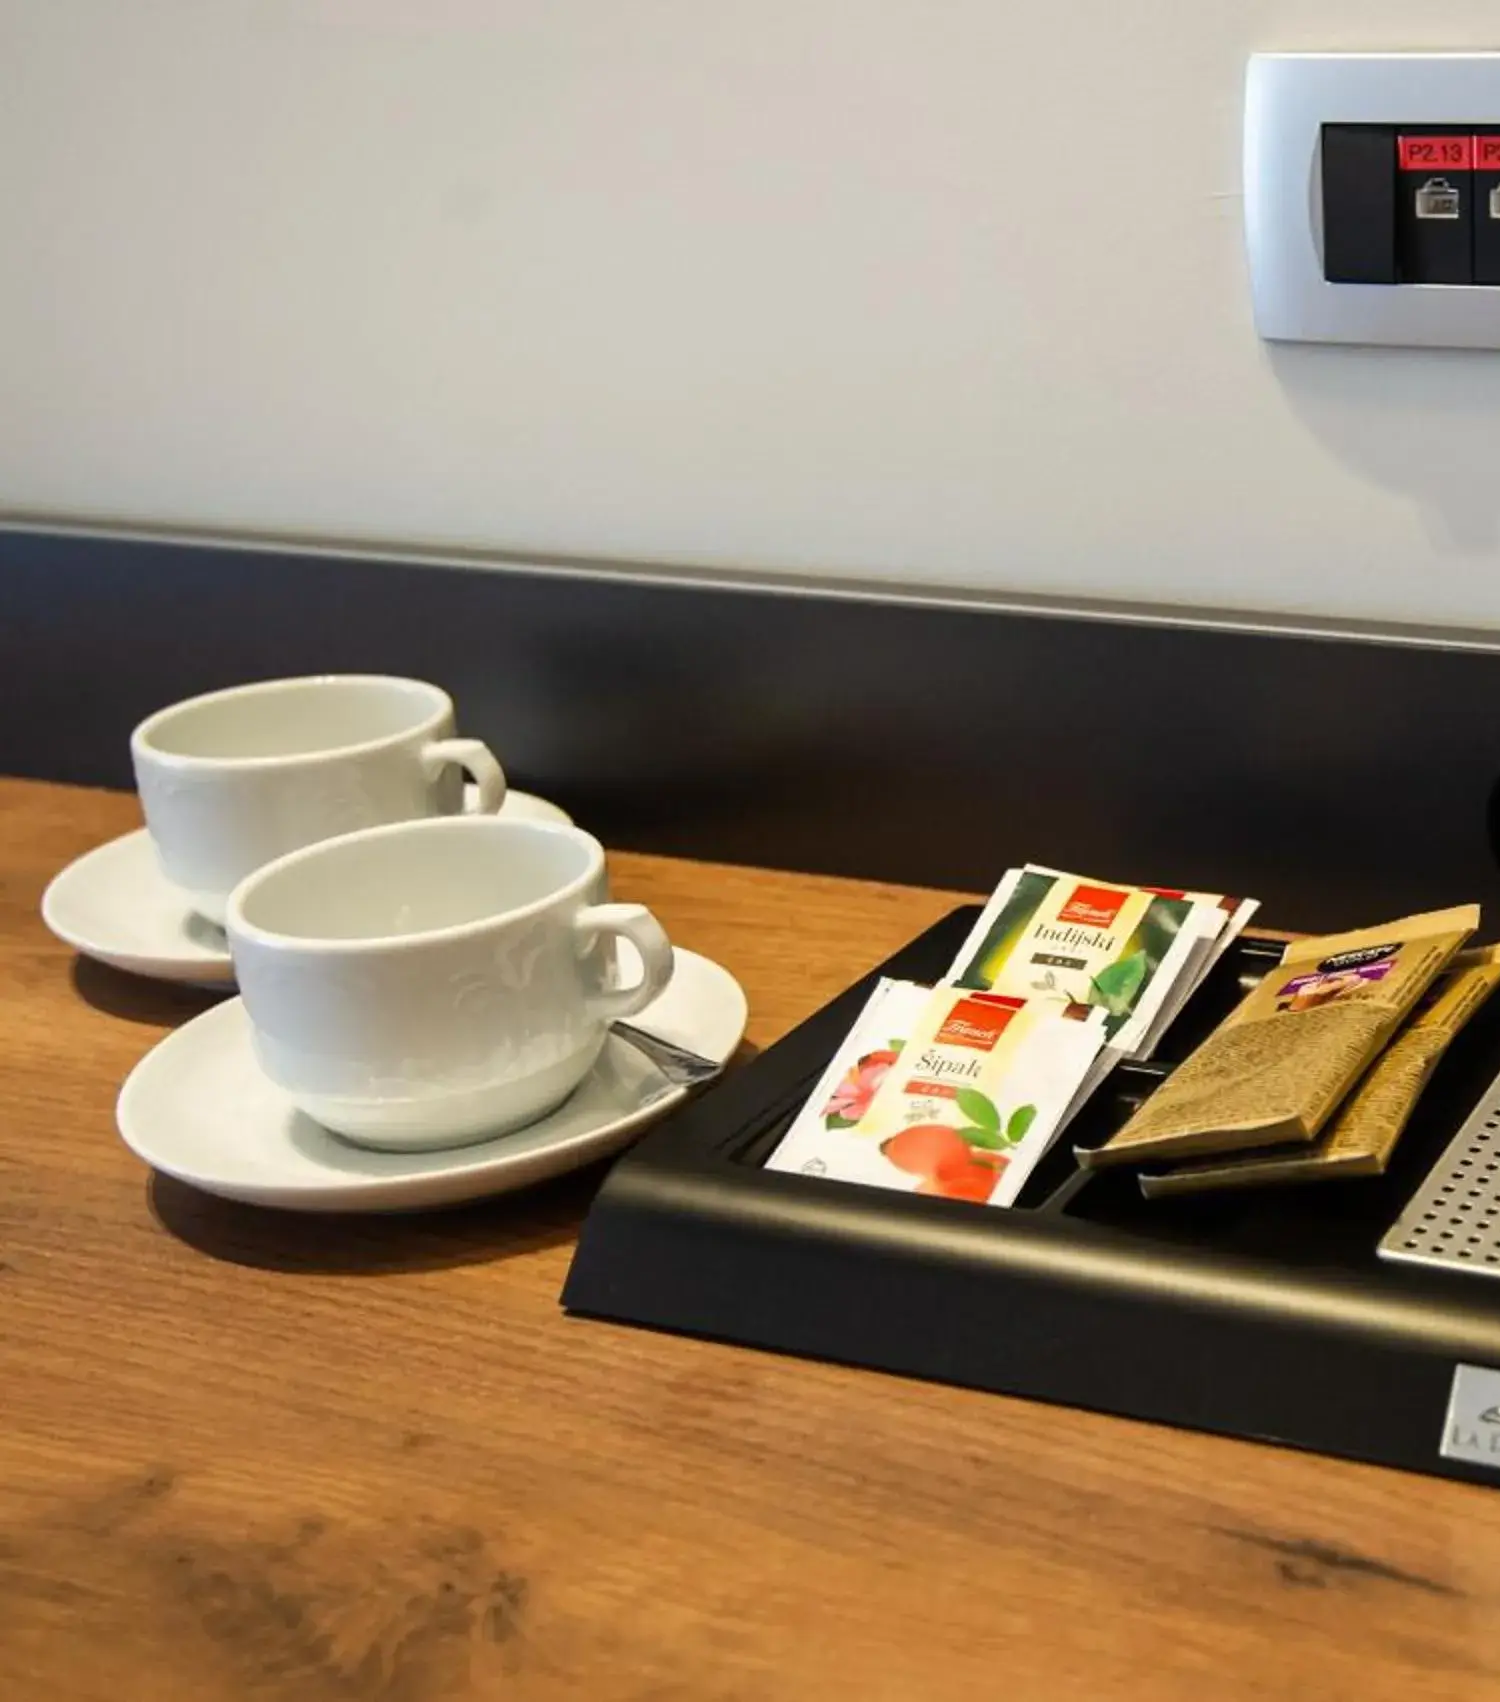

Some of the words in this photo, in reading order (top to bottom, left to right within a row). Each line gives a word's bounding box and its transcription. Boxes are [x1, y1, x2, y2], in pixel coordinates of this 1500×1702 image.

[1408, 144, 1463, 162] P2.13
[1033, 923, 1116, 951] Indijski
[915, 1048, 982, 1079] Šipak
